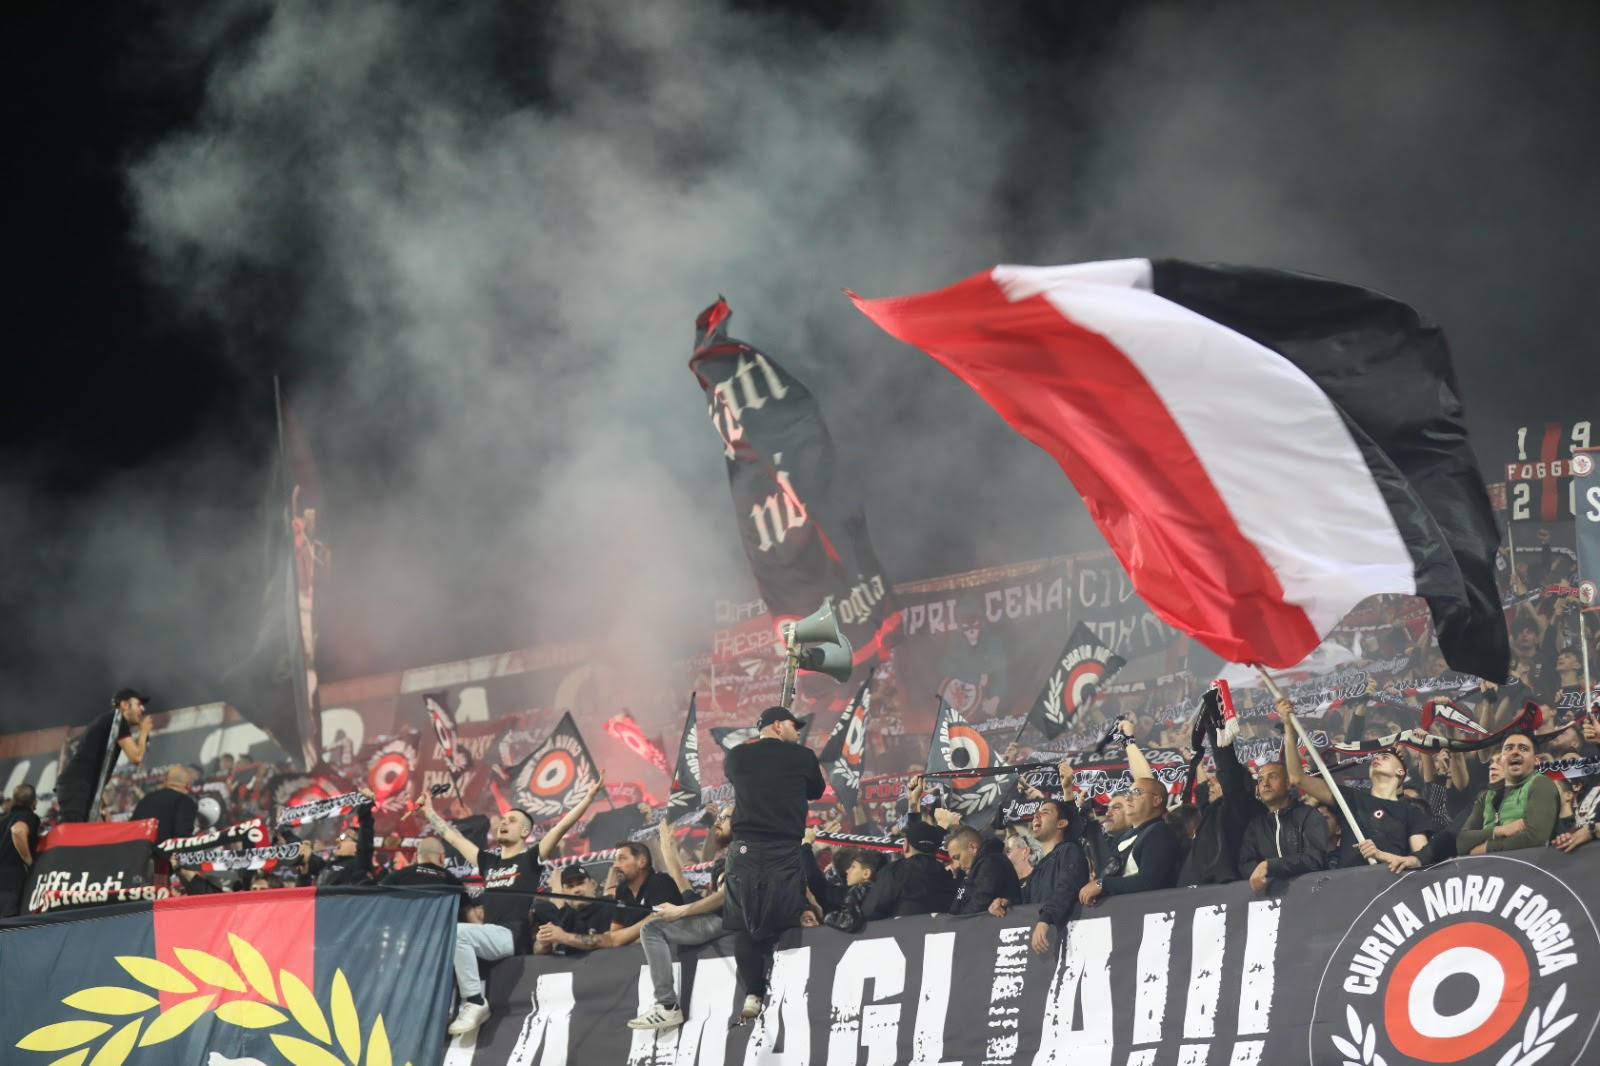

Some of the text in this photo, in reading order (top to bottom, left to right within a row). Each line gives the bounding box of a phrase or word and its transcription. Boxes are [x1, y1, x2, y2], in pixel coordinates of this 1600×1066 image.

[1569, 421, 1591, 454] 9
[1507, 459, 1576, 480] FOGGI
[898, 577, 1063, 637] PRI CENA
[1343, 874, 1578, 996] CURVA NORD FOGGIA
